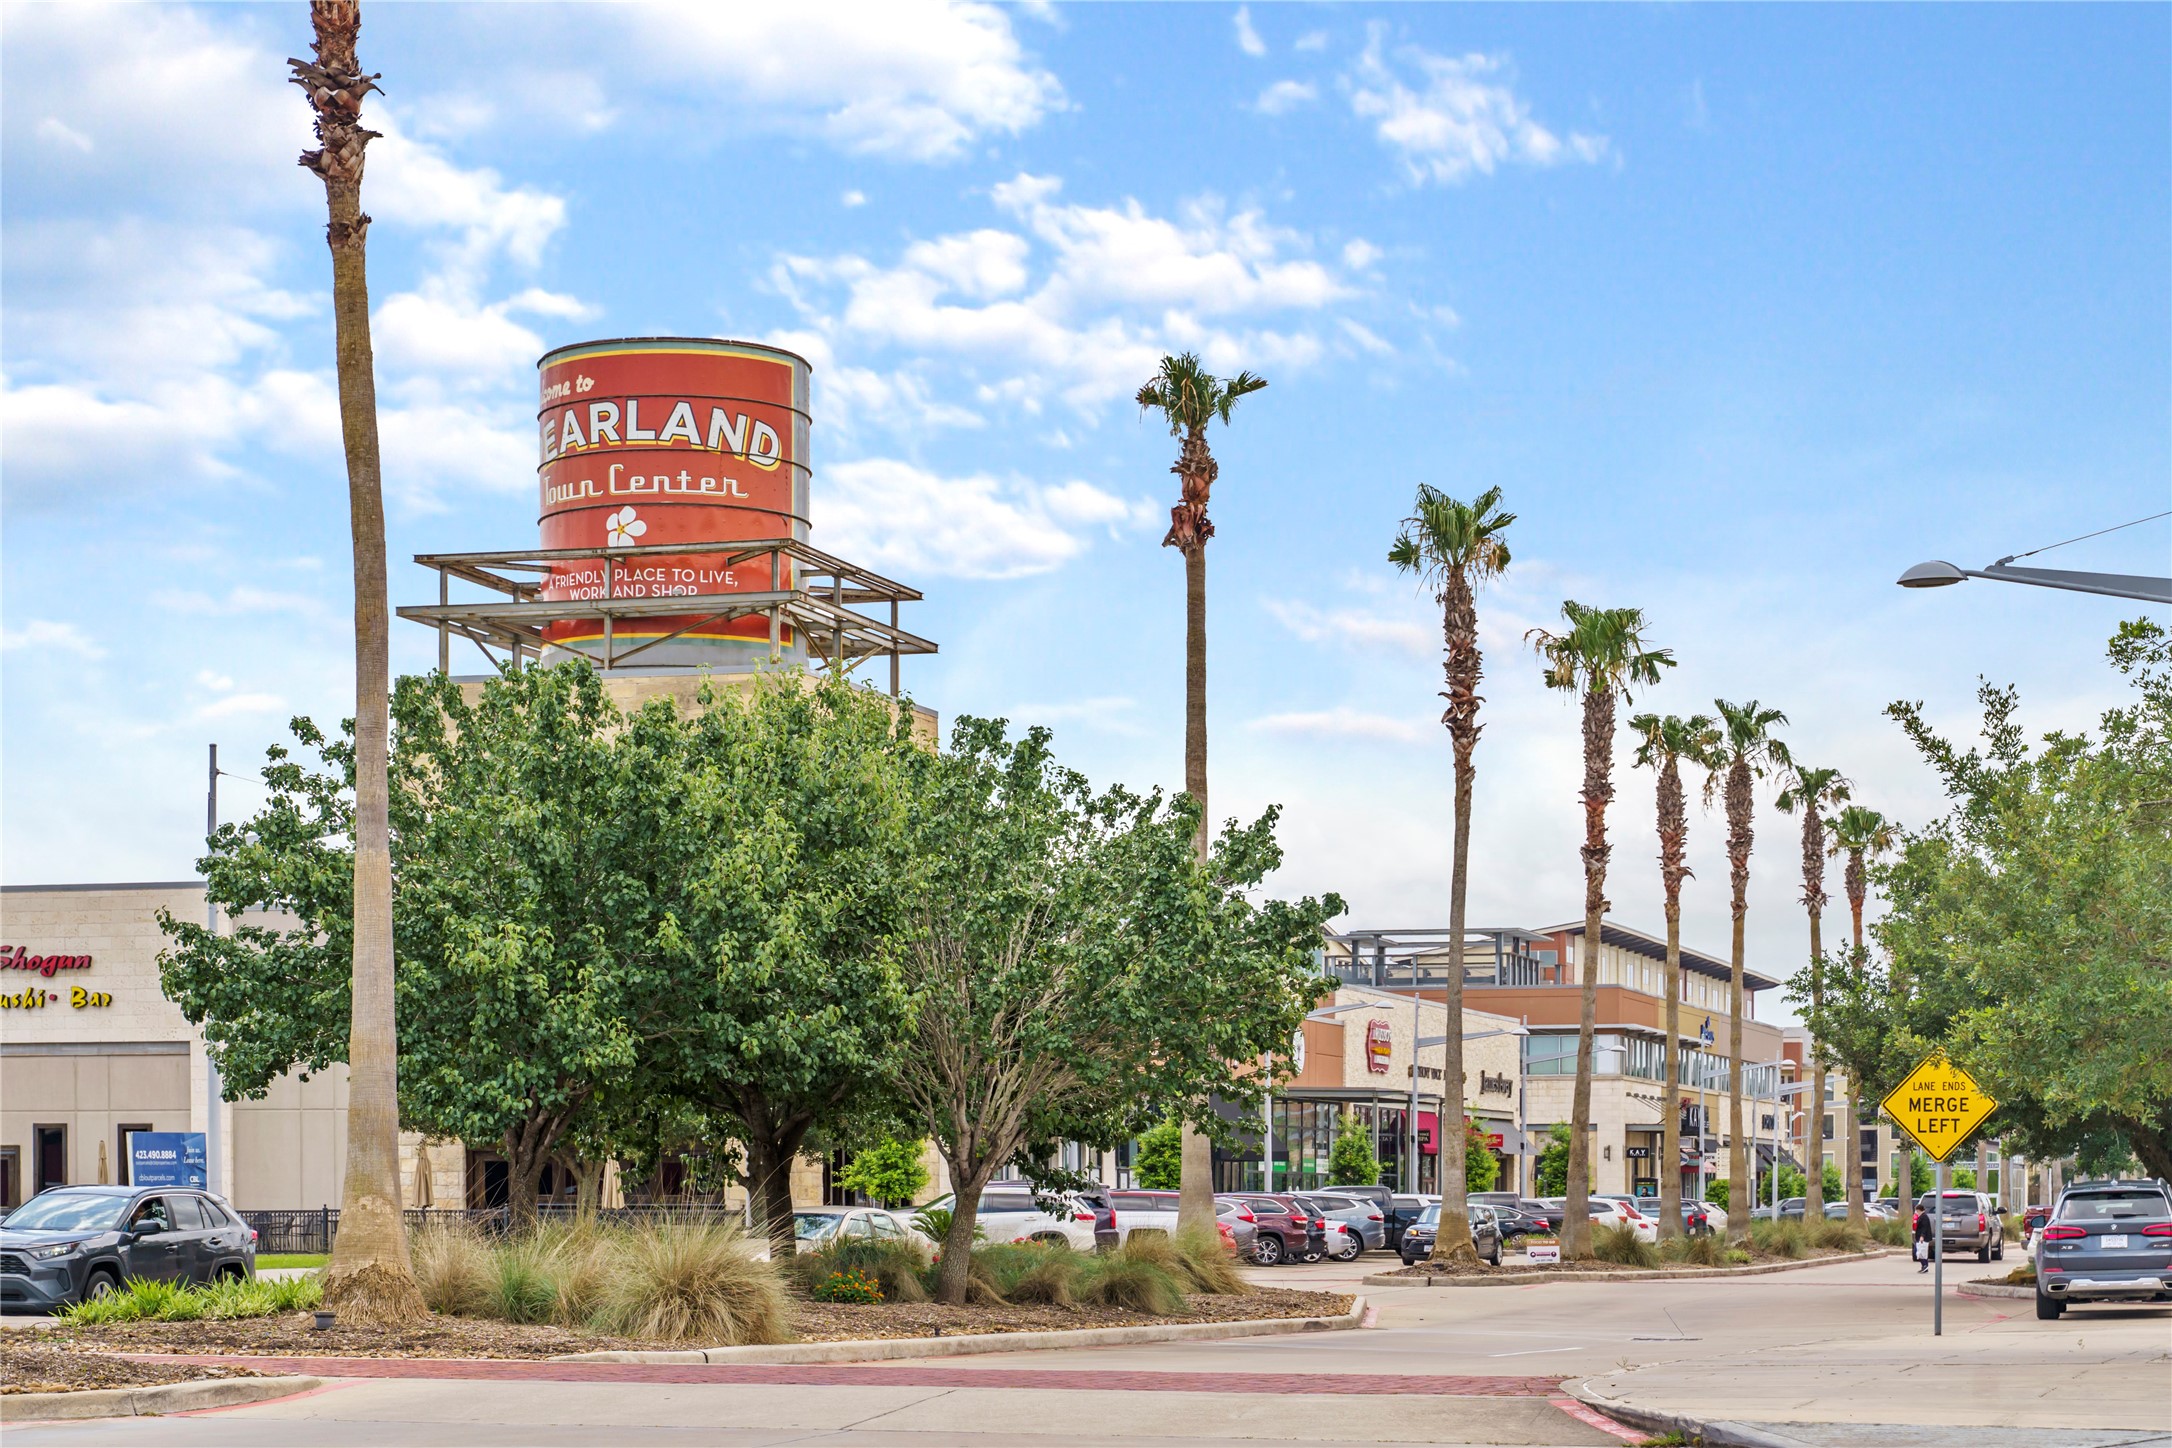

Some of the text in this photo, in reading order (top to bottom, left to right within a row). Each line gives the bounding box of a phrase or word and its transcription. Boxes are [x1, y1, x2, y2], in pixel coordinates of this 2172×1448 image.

[576, 374, 595, 393] to
[544, 463, 749, 505] Town Center
[555, 569, 606, 589] FRIENDLY
[614, 568, 666, 582] PLACE
[672, 568, 695, 582] TO
[699, 570, 738, 588] LIVE,
[569, 586, 606, 600] WORK
[613, 584, 646, 598] AND
[0, 945, 92, 977] Shogun
[70, 986, 112, 1009] Bar
[1913, 1082, 1966, 1091] LANE ENDS
[1909, 1097, 1969, 1112] MERGE
[1918, 1118, 1960, 1133] LEFT
[135, 1150, 177, 1159] 423.490.8884
